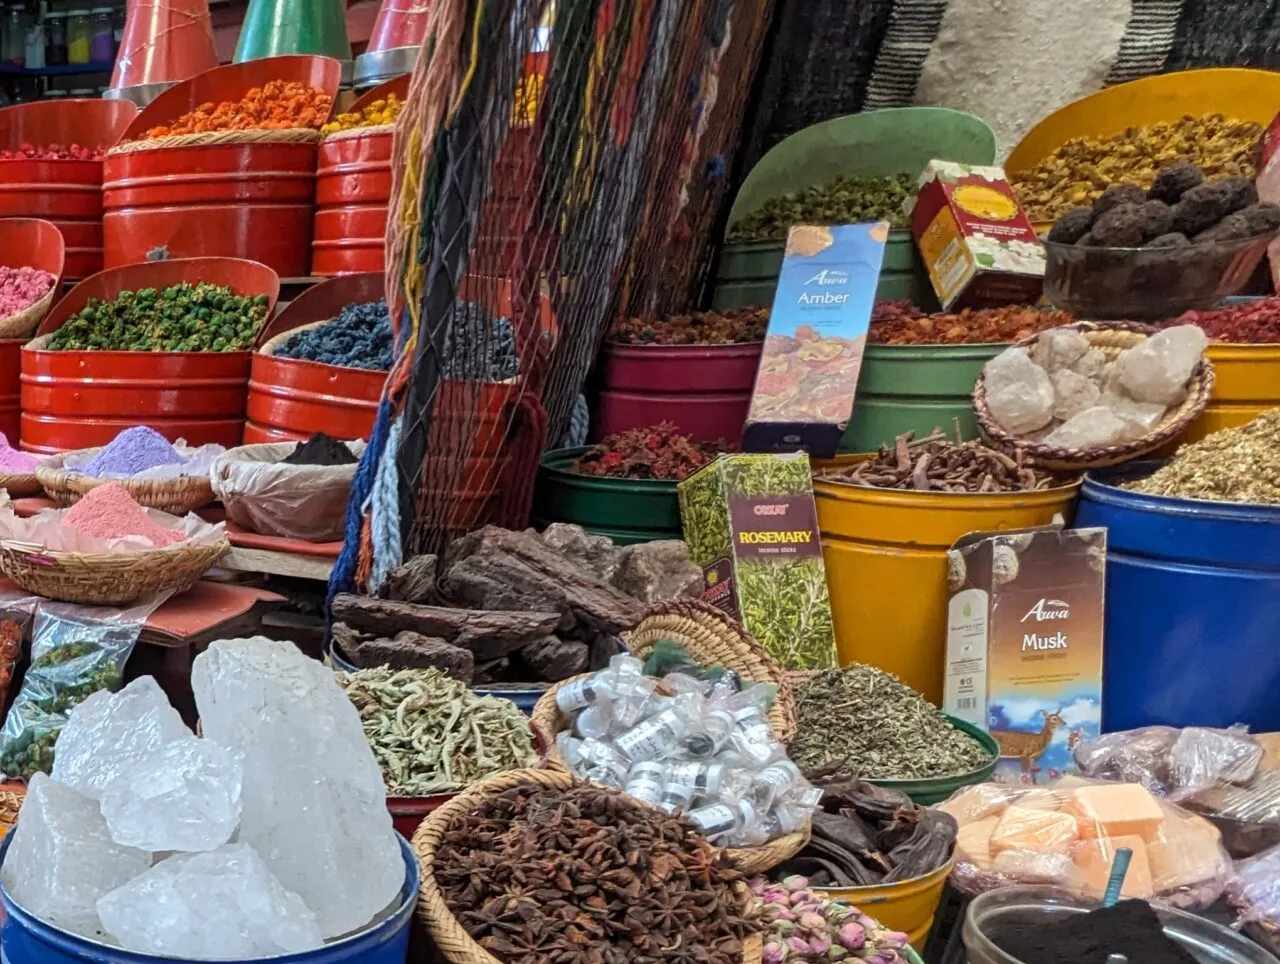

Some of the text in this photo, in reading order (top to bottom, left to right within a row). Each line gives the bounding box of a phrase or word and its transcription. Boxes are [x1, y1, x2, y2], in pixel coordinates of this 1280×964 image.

[797, 291, 850, 304] Amber
[739, 531, 812, 544] ROSEMARY
[1022, 631, 1068, 651] Musk
